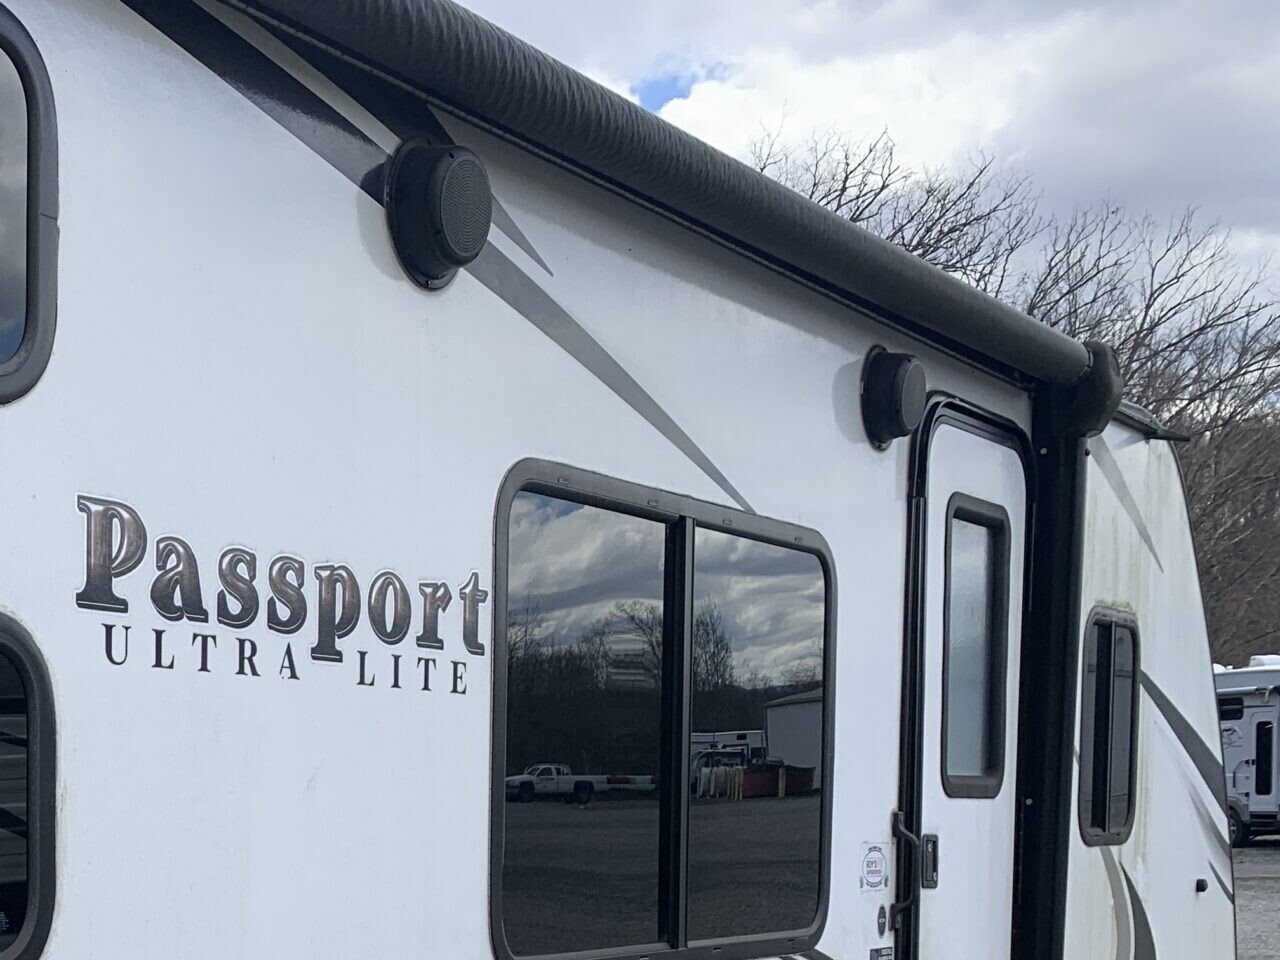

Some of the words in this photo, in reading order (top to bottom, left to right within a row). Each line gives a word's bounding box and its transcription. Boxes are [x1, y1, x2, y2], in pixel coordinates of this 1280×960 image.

[75, 493, 489, 663] Passport
[101, 622, 301, 681] ULTRA
[356, 649, 468, 696] LITE
